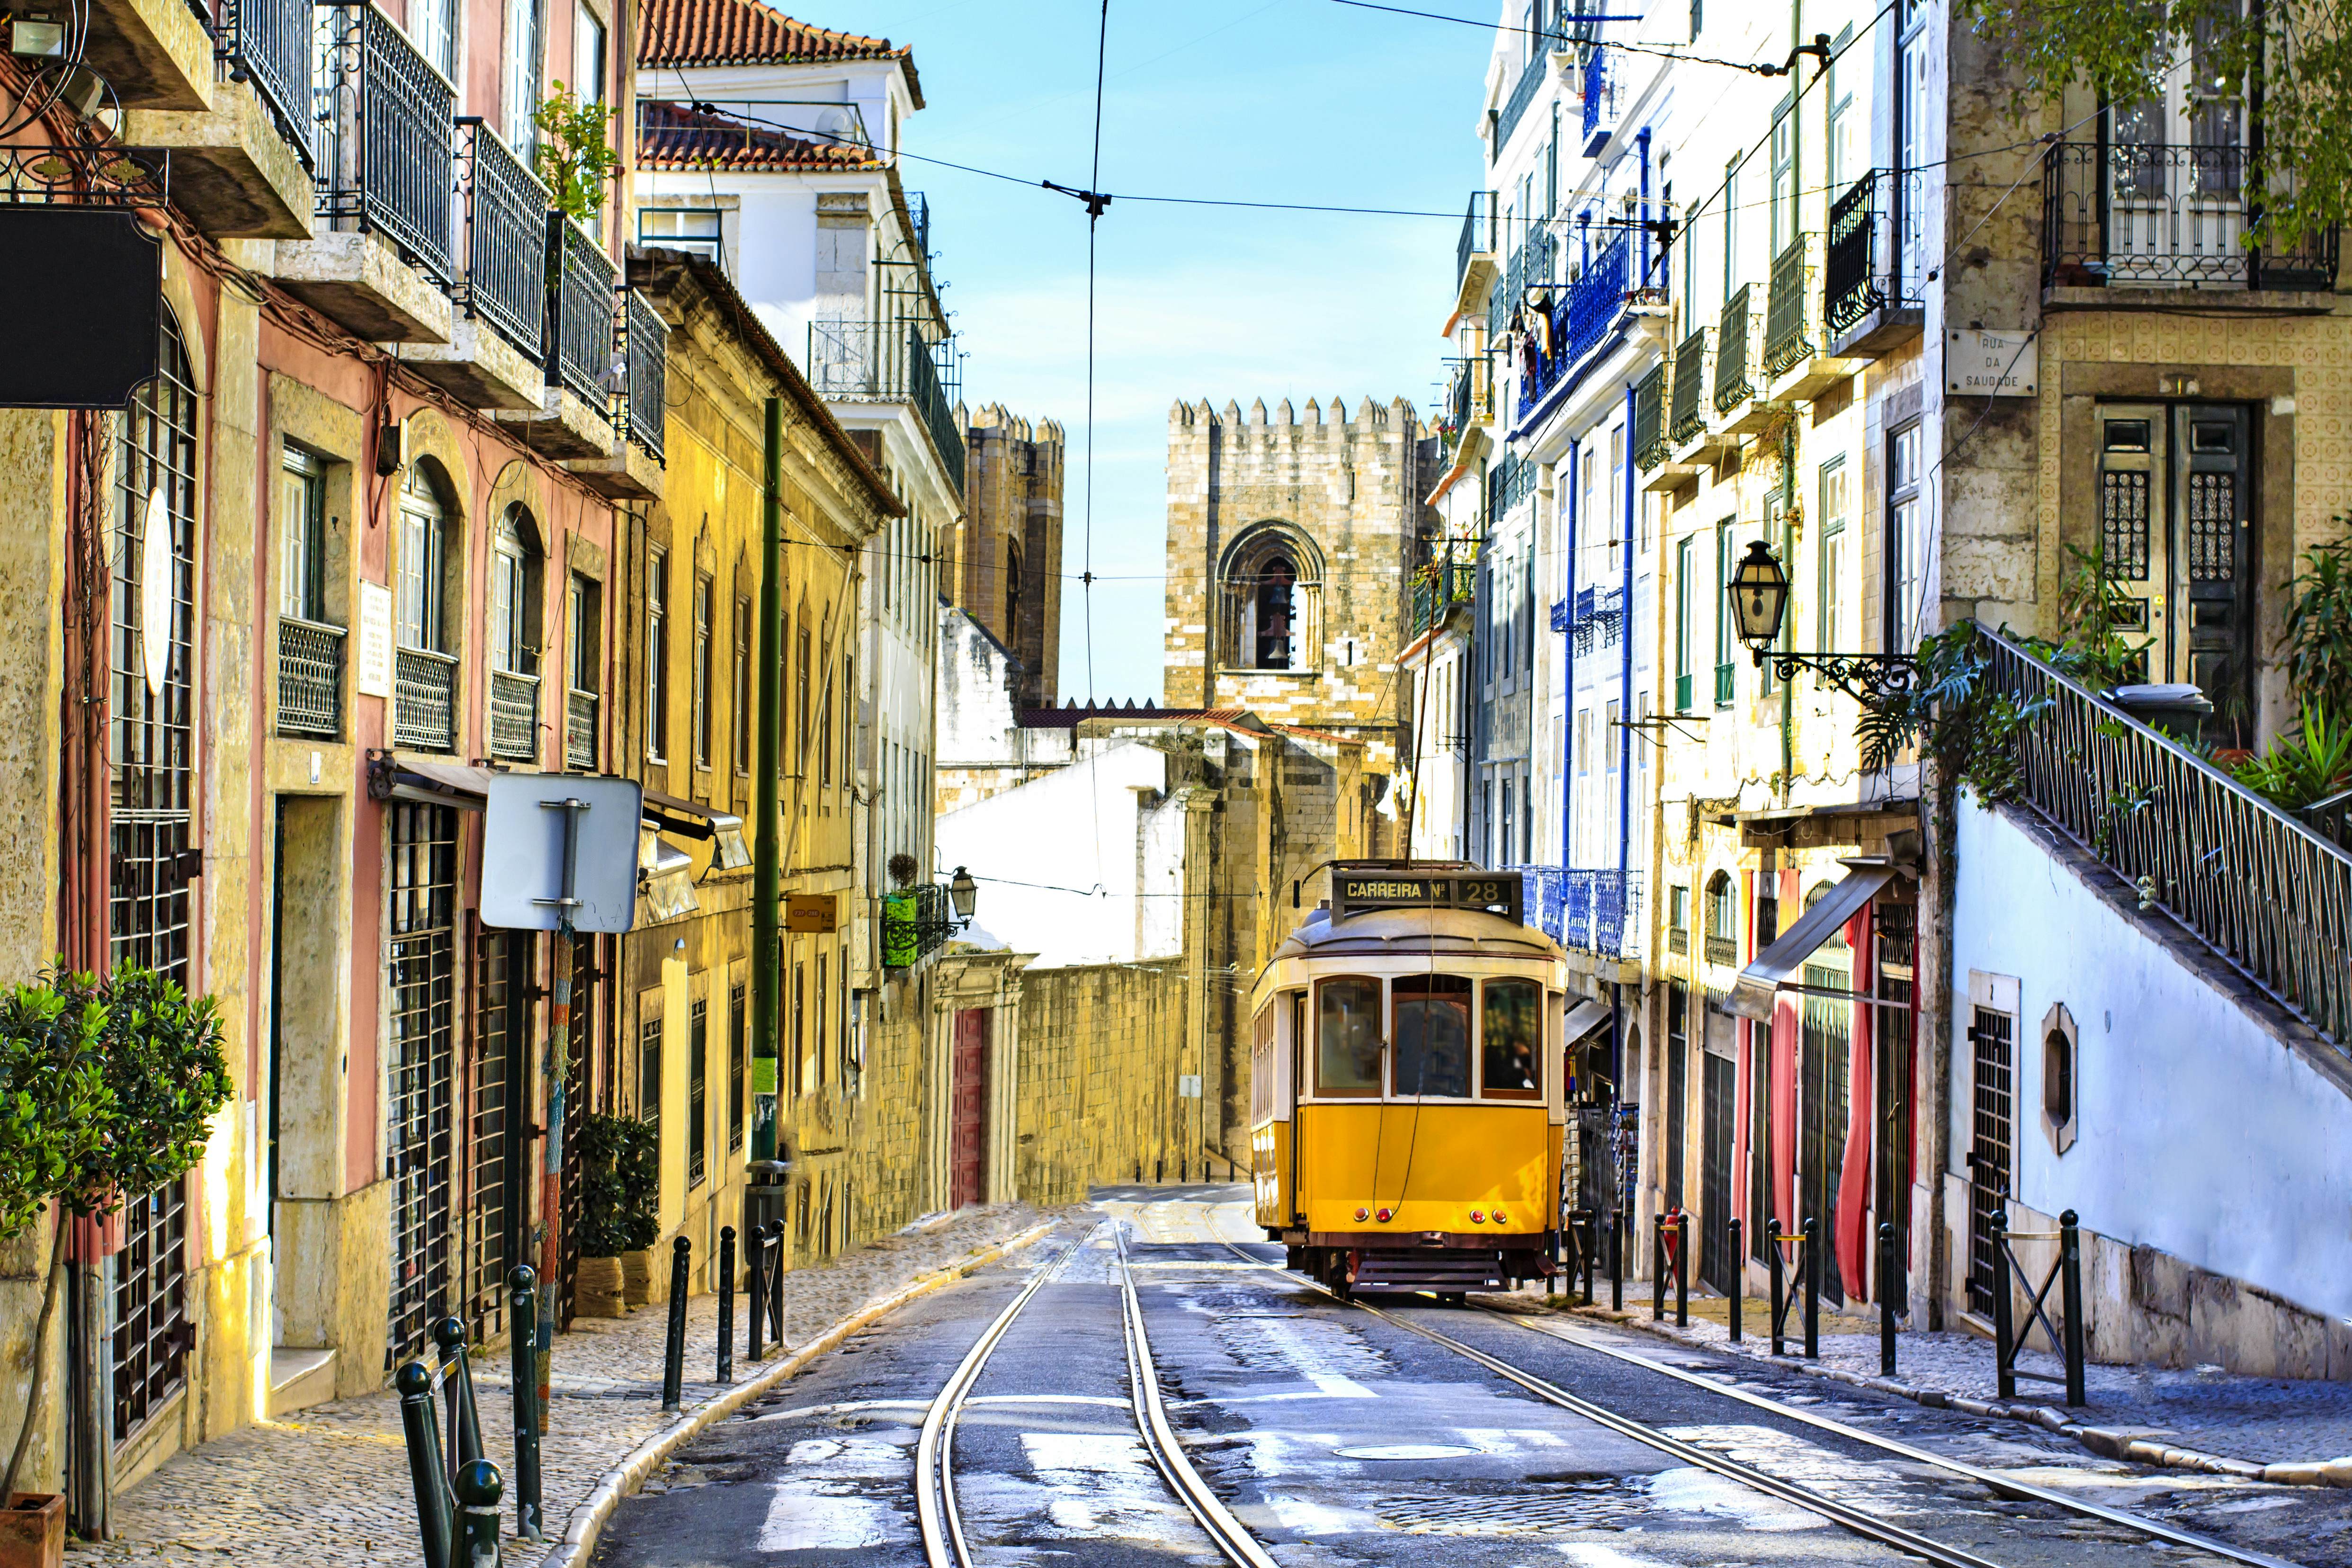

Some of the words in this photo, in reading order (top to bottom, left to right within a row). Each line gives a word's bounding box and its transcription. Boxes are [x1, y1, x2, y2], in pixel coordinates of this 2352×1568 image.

[1983, 338, 2003, 349] RUA
[1986, 357, 2000, 367] DA
[1967, 376, 2018, 386] SAUDADE
[1347, 883, 1422, 897] CARREIRA
[1467, 882, 1499, 902] 28
